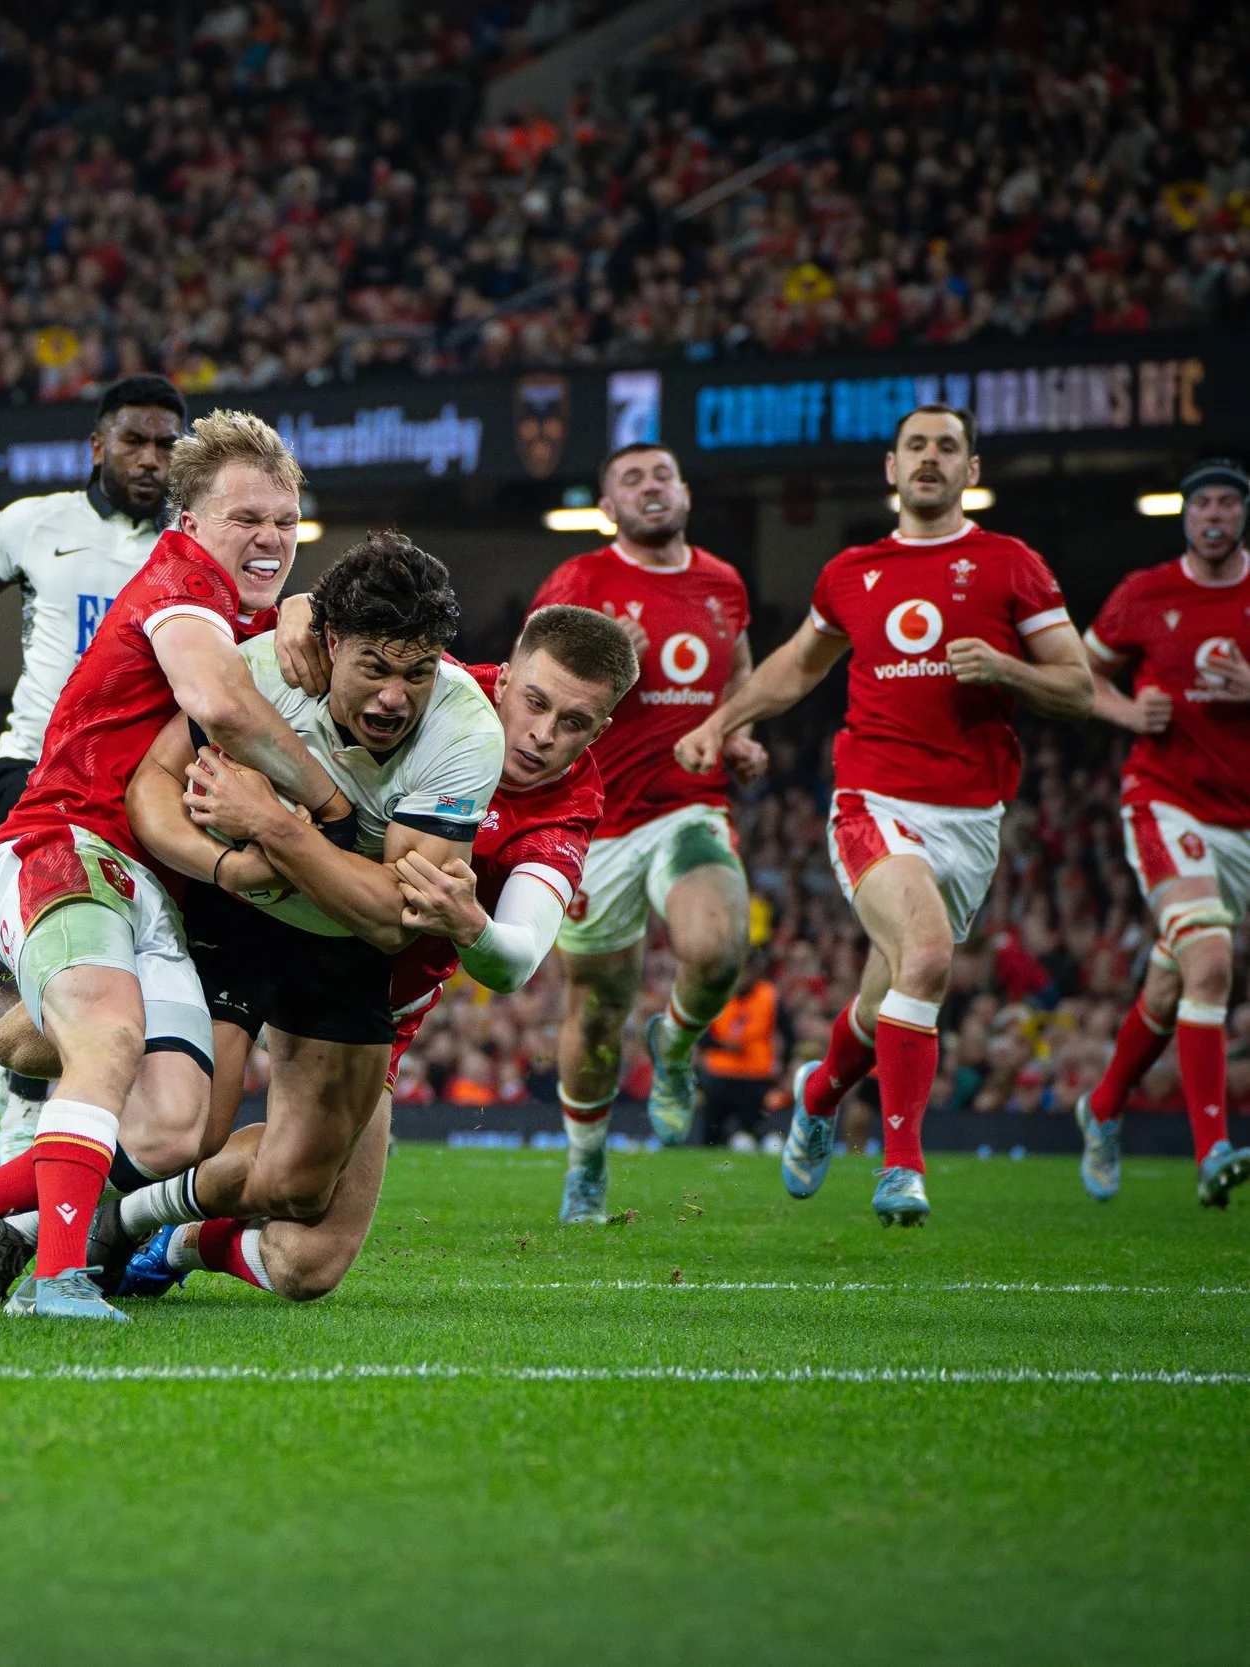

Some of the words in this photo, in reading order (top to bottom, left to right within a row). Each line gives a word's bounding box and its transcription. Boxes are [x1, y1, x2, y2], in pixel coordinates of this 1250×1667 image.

[696, 380, 827, 450] CARDIFF
[976, 362, 1132, 436] DRAGONS
[1138, 358, 1204, 425] RFC
[873, 657, 952, 680] vodafon
